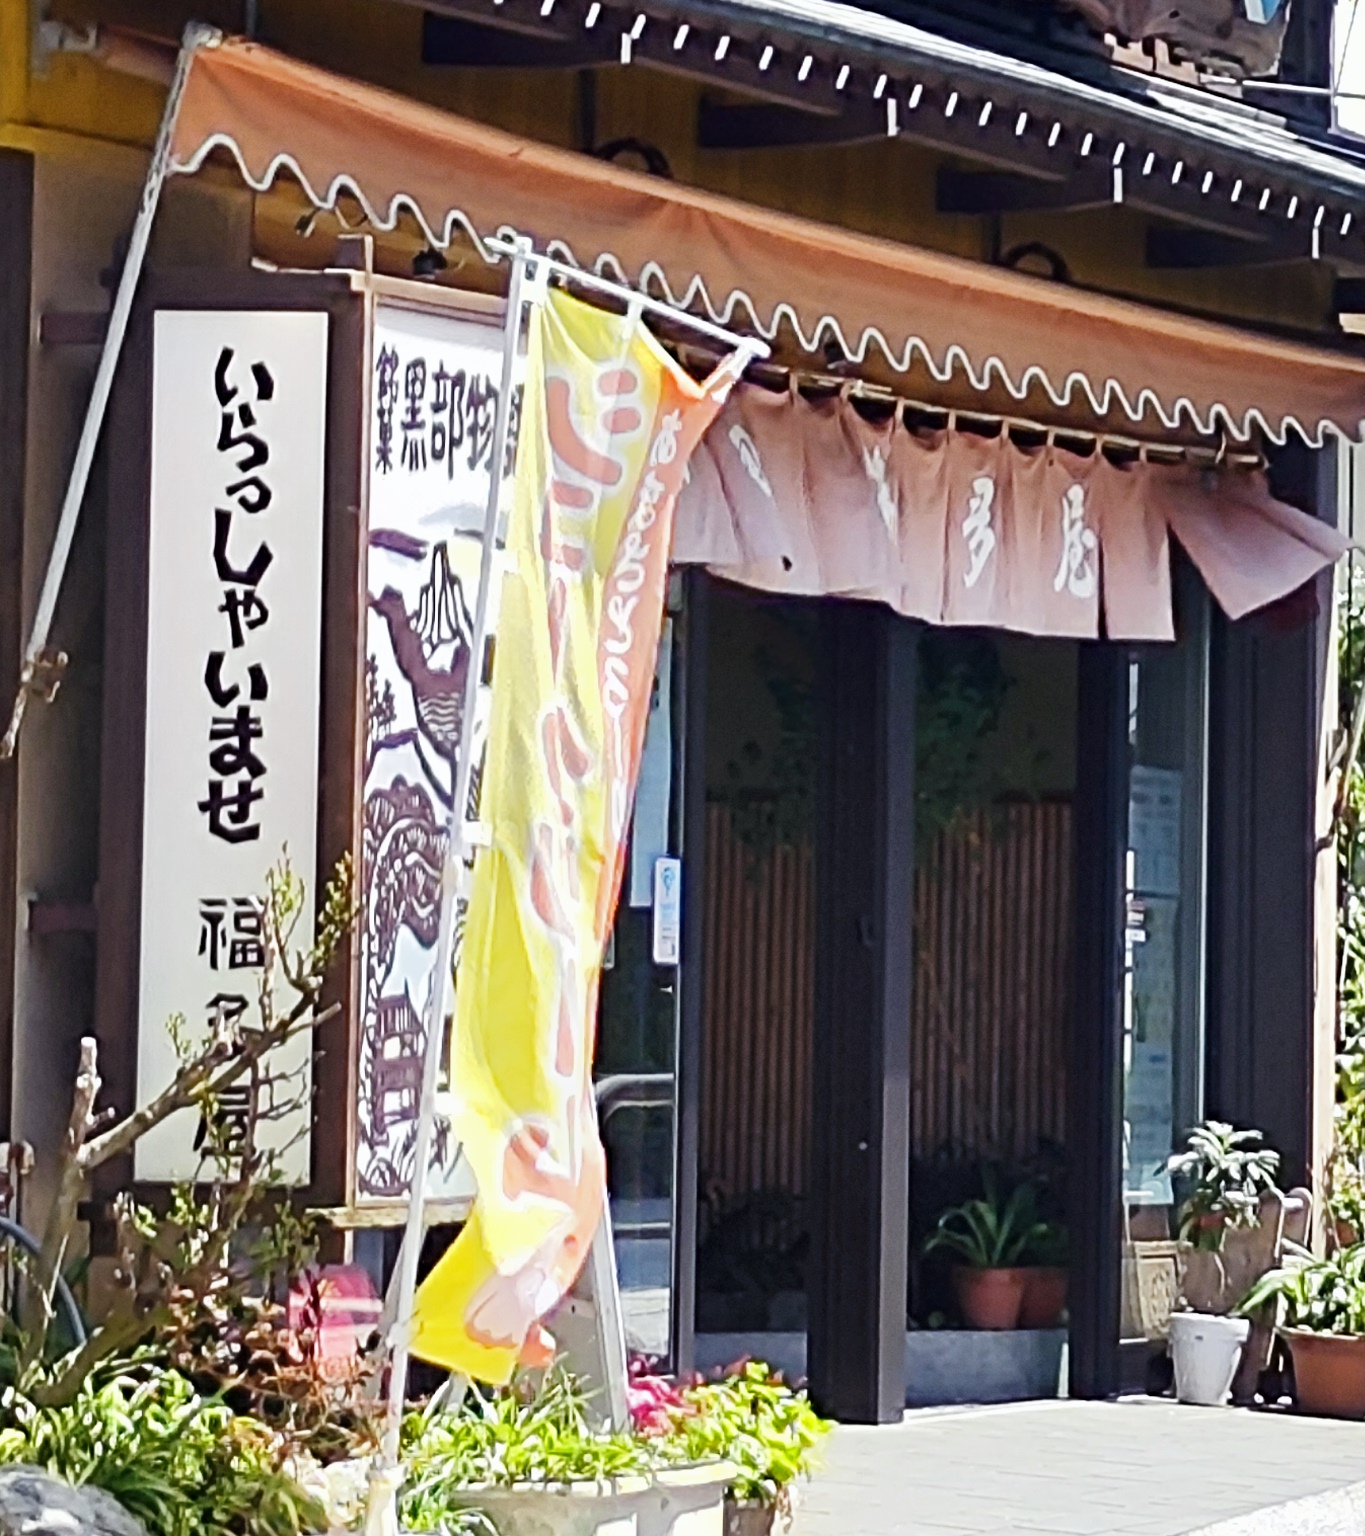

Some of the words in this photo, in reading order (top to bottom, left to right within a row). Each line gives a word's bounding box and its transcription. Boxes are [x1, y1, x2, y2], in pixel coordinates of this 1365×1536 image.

[199, 347, 274, 844] いらっしゃいませ
